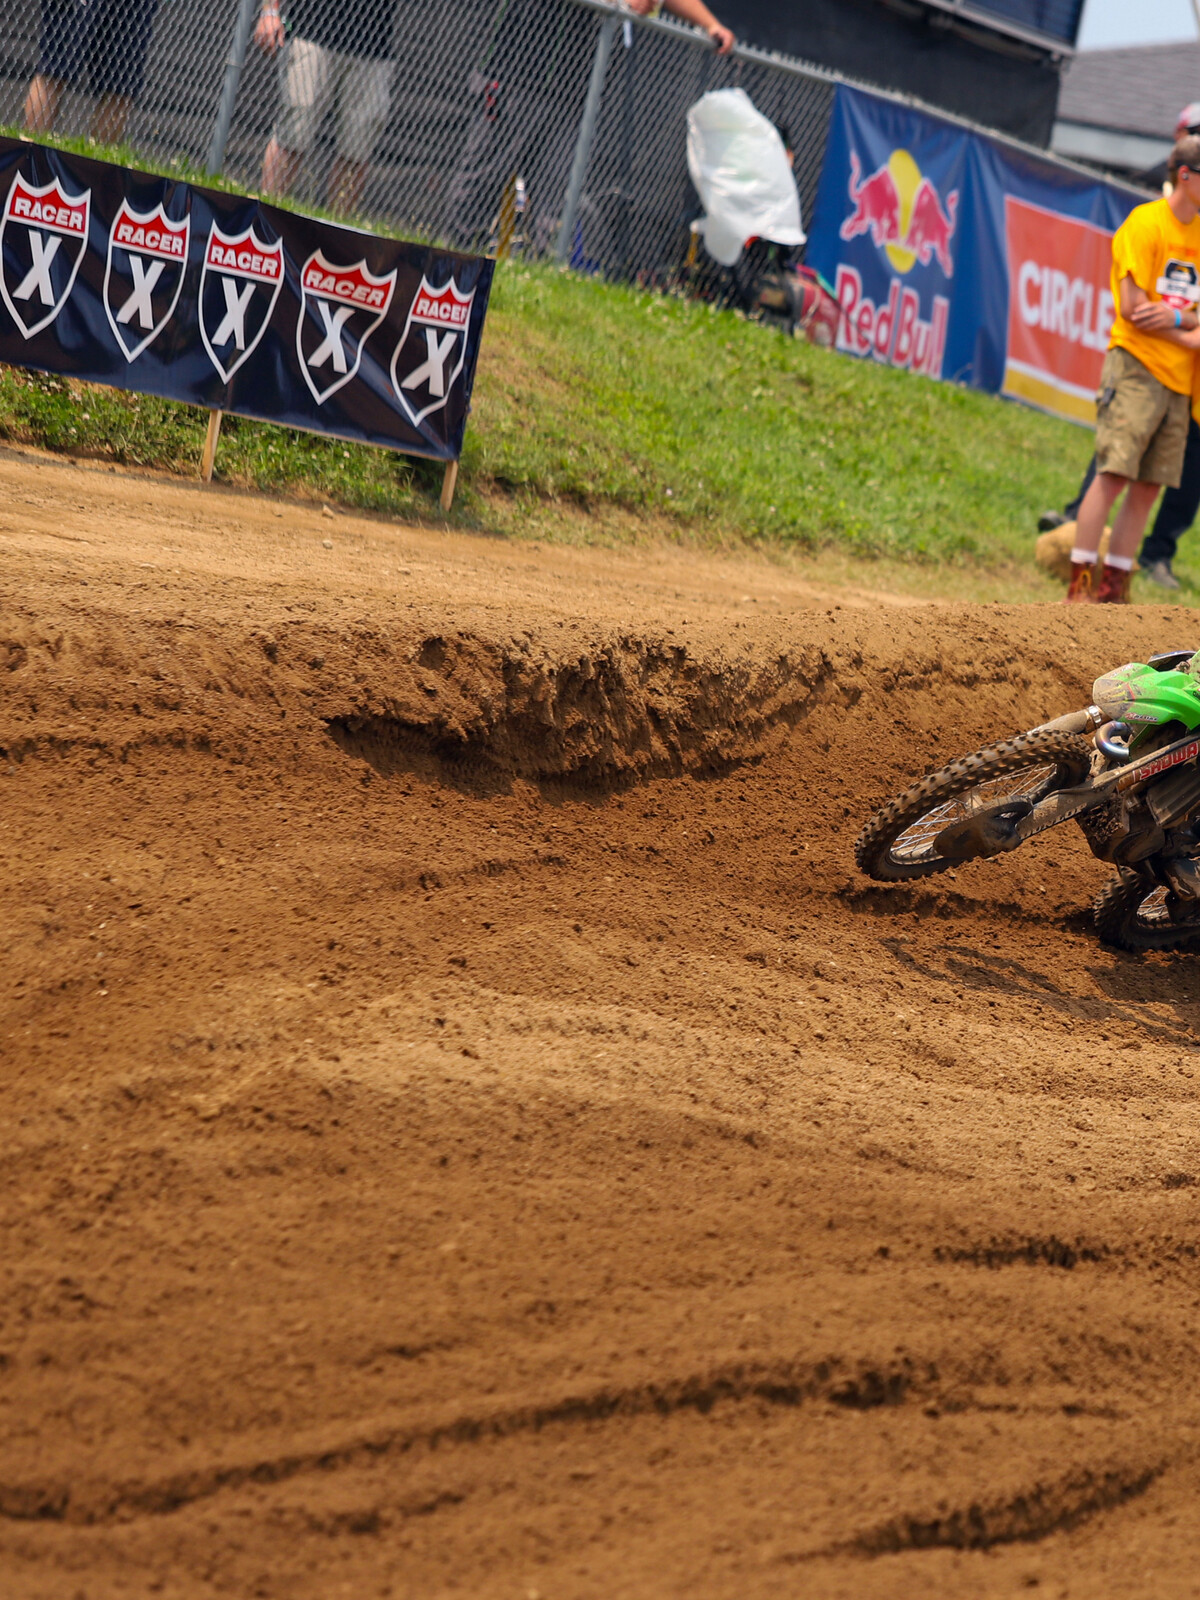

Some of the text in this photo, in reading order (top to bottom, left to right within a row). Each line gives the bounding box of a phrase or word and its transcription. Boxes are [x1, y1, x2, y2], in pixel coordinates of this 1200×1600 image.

[14, 199, 84, 230] RACER
[117, 223, 184, 254] RACER
[13, 230, 62, 307] X
[117, 254, 165, 330] X
[210, 245, 279, 276] RACER
[306, 270, 385, 307] RACER
[211, 277, 256, 350] X
[308, 301, 354, 373] X
[1018, 259, 1114, 353] CIRCLE
[400, 327, 457, 397] X
[1140, 742, 1200, 780] SHOWA
